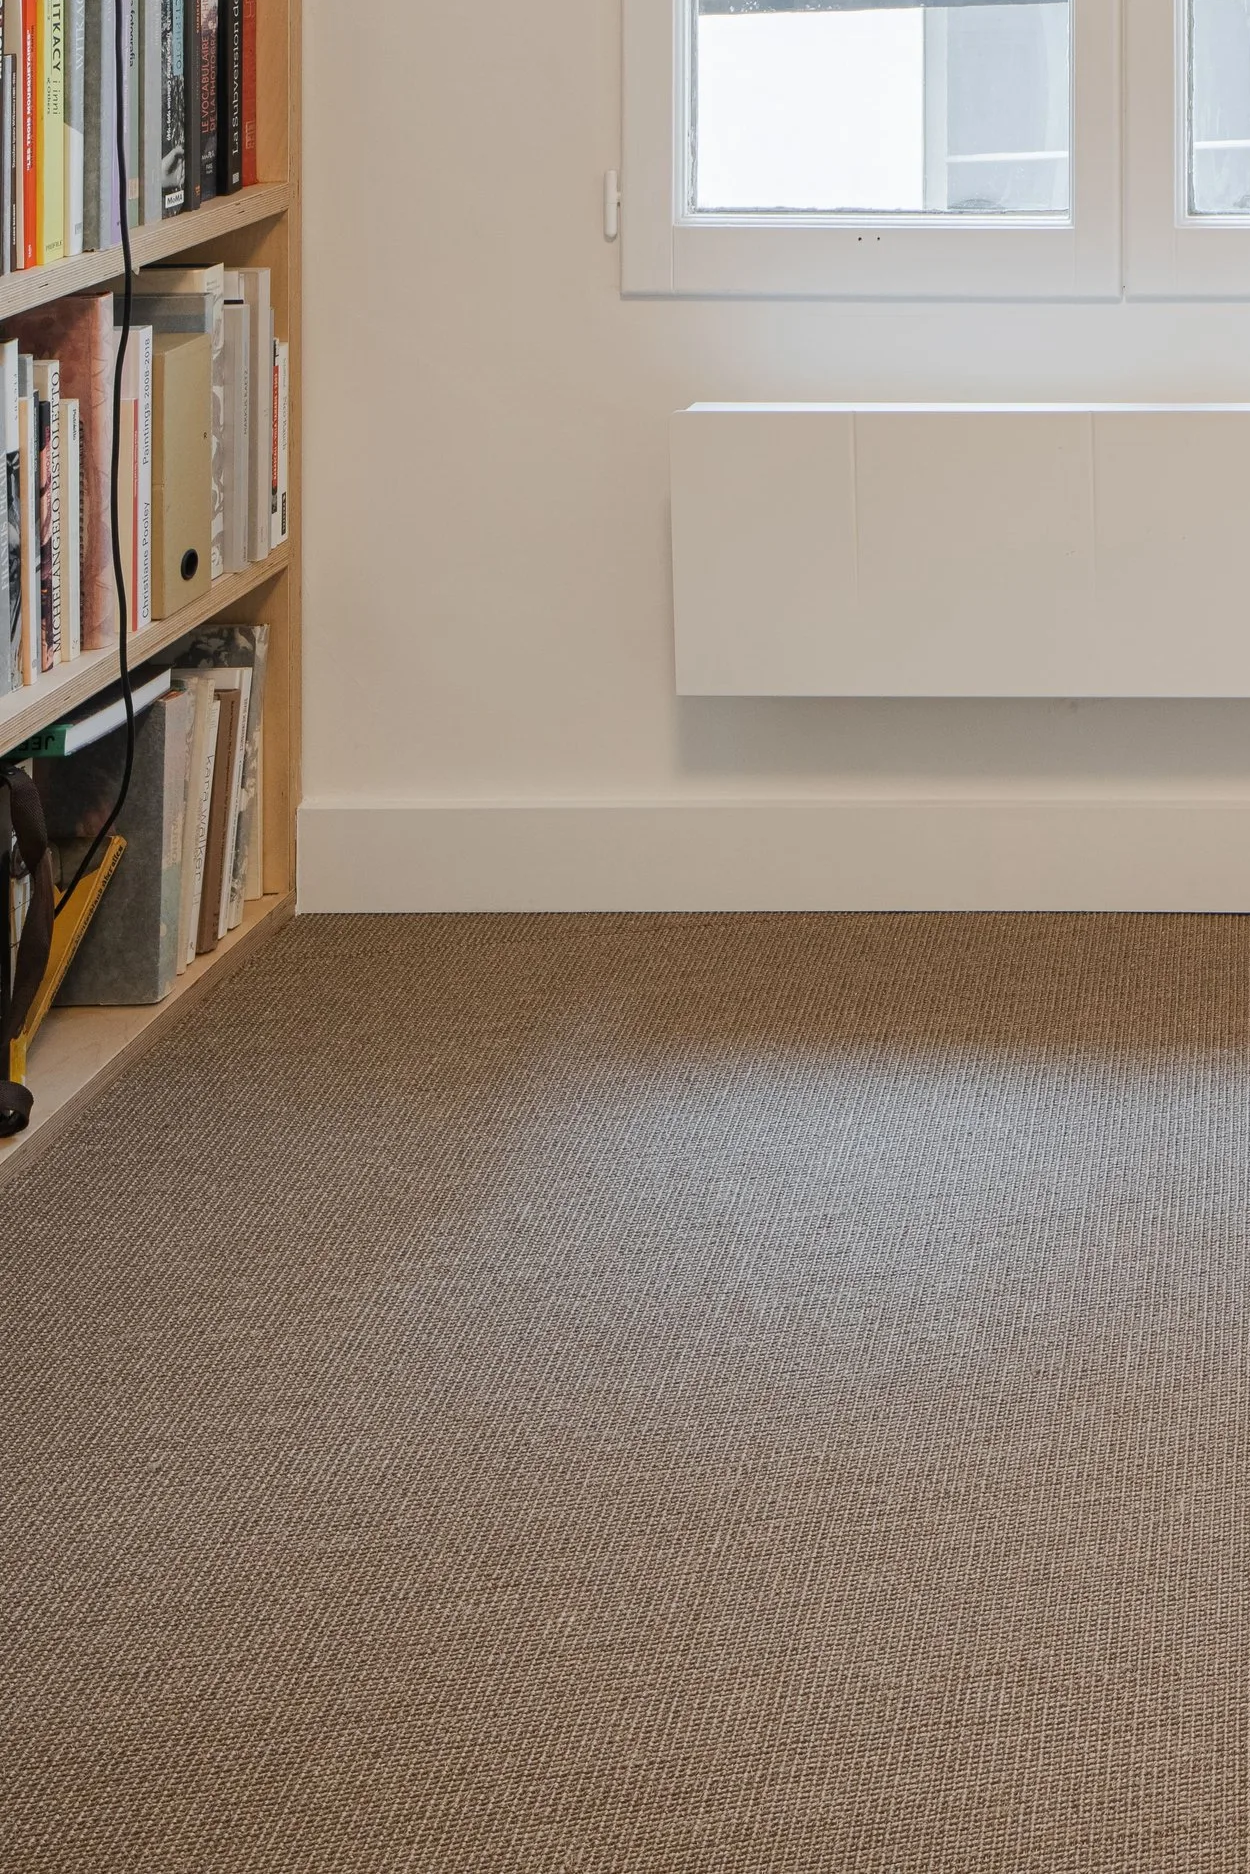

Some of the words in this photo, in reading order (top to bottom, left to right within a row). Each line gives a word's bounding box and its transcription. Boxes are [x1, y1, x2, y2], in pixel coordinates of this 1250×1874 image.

[210, 98, 216, 113] LA
[202, 120, 209, 133] LE
[210, 118, 216, 131] DE
[232, 131, 239, 155] La
[167, 192, 184, 205] MoMA
[52, 372, 60, 493] PISTOLETTO
[1, 521, 9, 591] FRANCIS
[52, 498, 61, 653] MICHELANGELO
[200, 754, 215, 803] kara
[193, 808, 209, 882] walker
